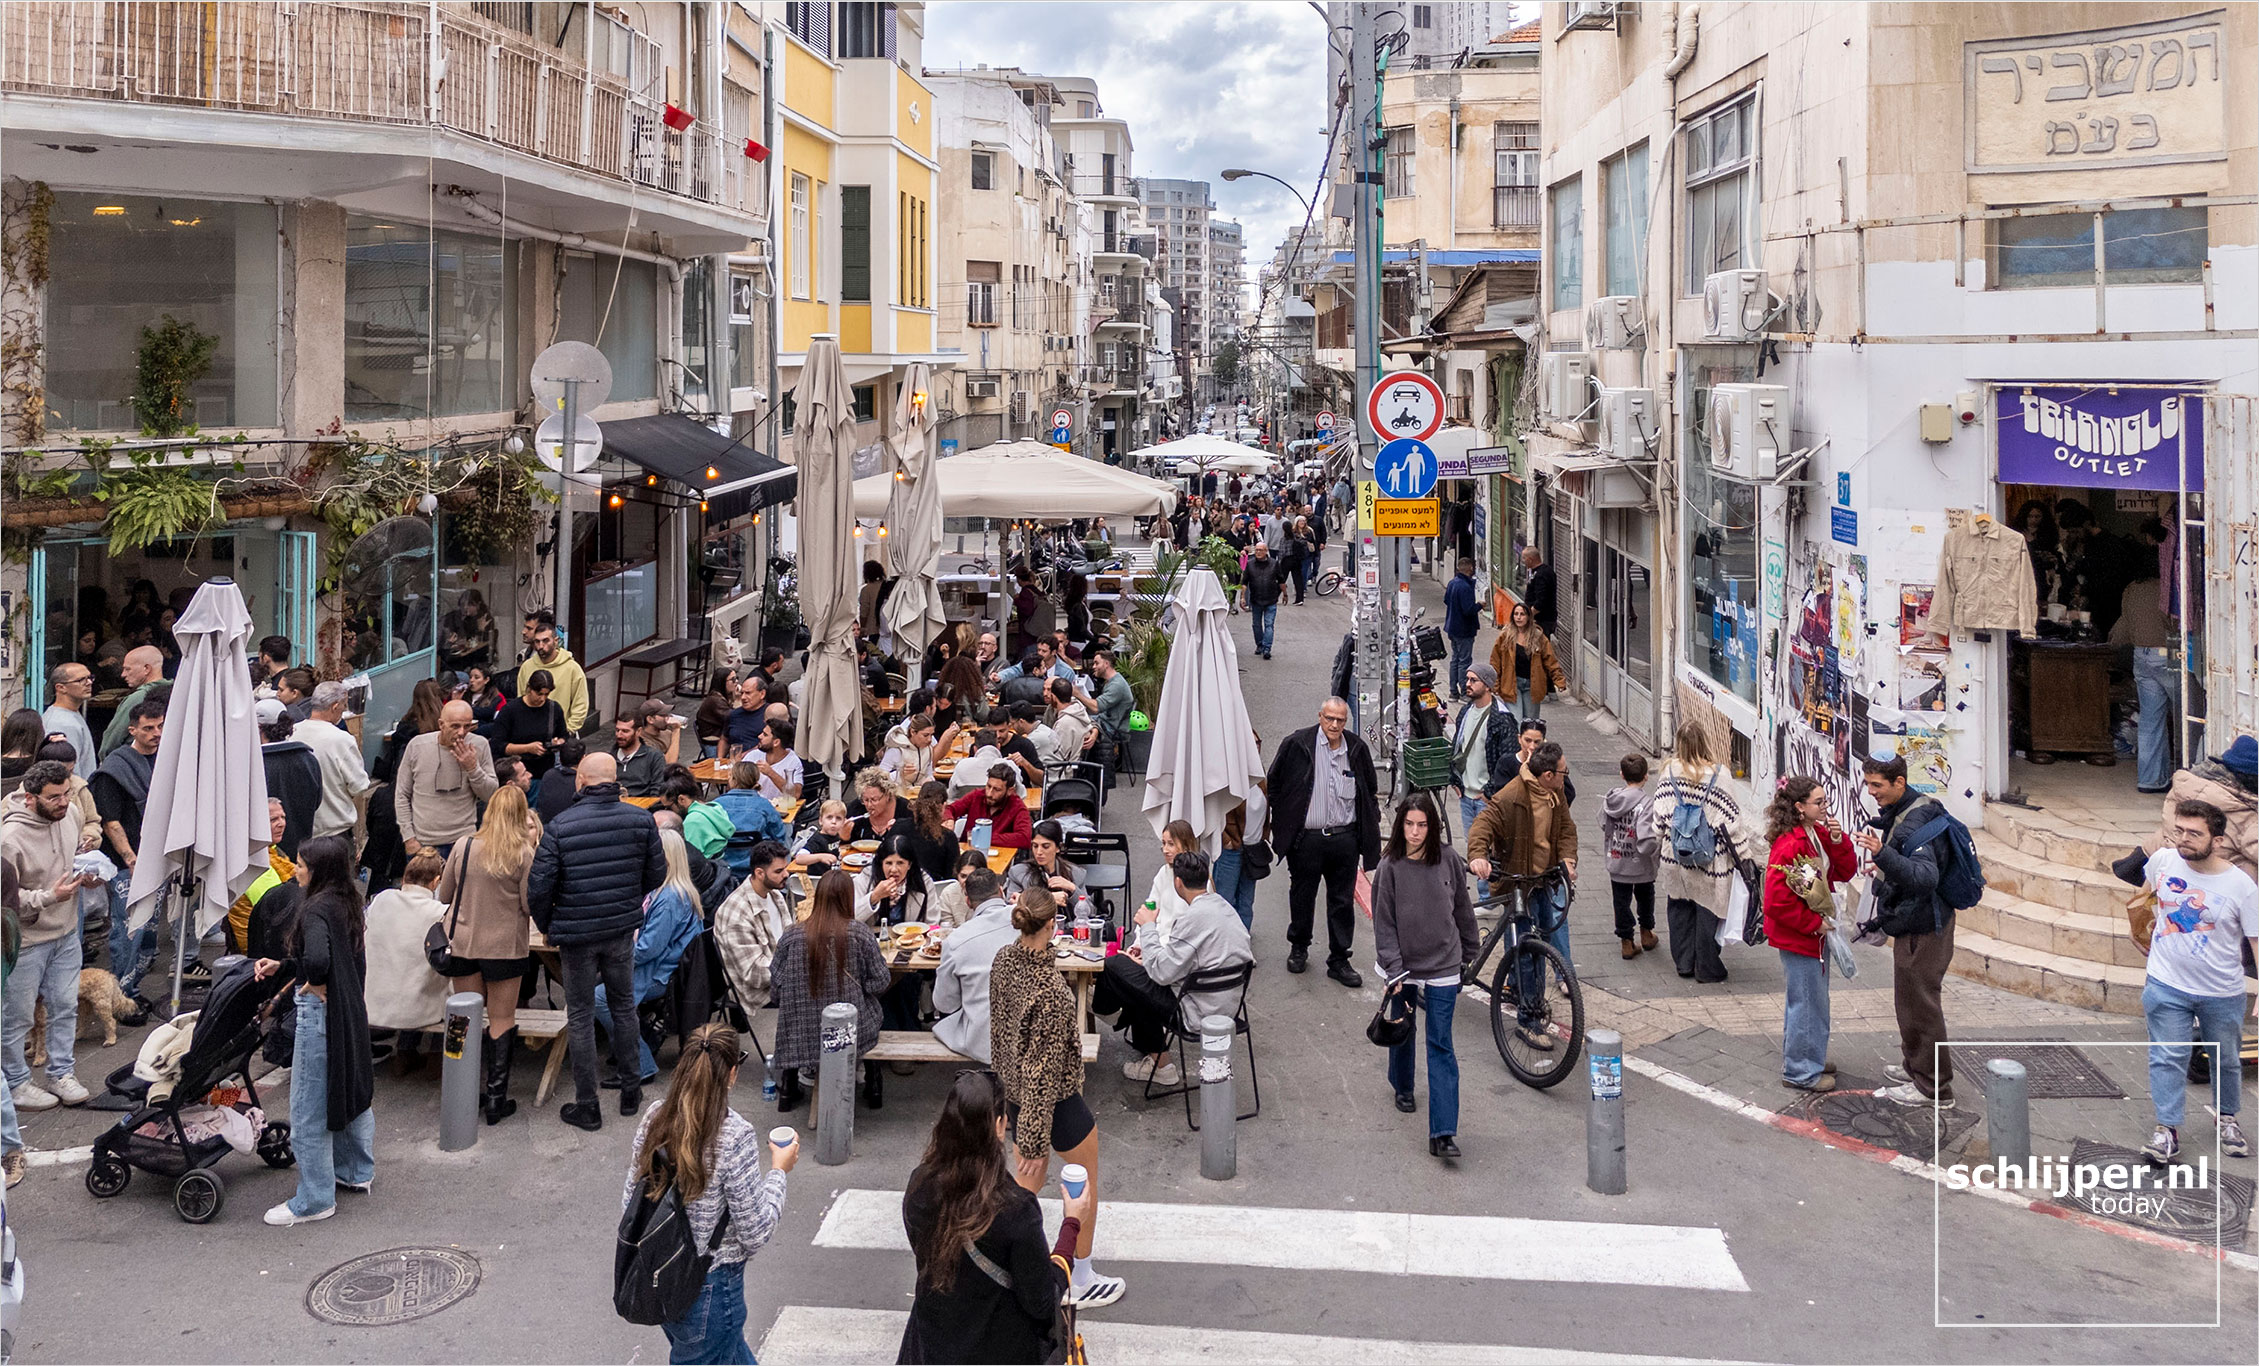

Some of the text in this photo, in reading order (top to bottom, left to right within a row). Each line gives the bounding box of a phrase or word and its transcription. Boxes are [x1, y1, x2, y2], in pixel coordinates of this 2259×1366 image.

[1981, 31, 2218, 104] המשביר
[1438, 460, 1467, 470] UNDA
[1469, 454, 1508, 464] SEGUNDA
[2053, 446, 2148, 477] OUTLET
[1839, 478, 1849, 500] 37
[1364, 481, 1374, 519] 481
[1378, 506, 1435, 515] למעט אופניים
[1419, 520, 1431, 529] לא
